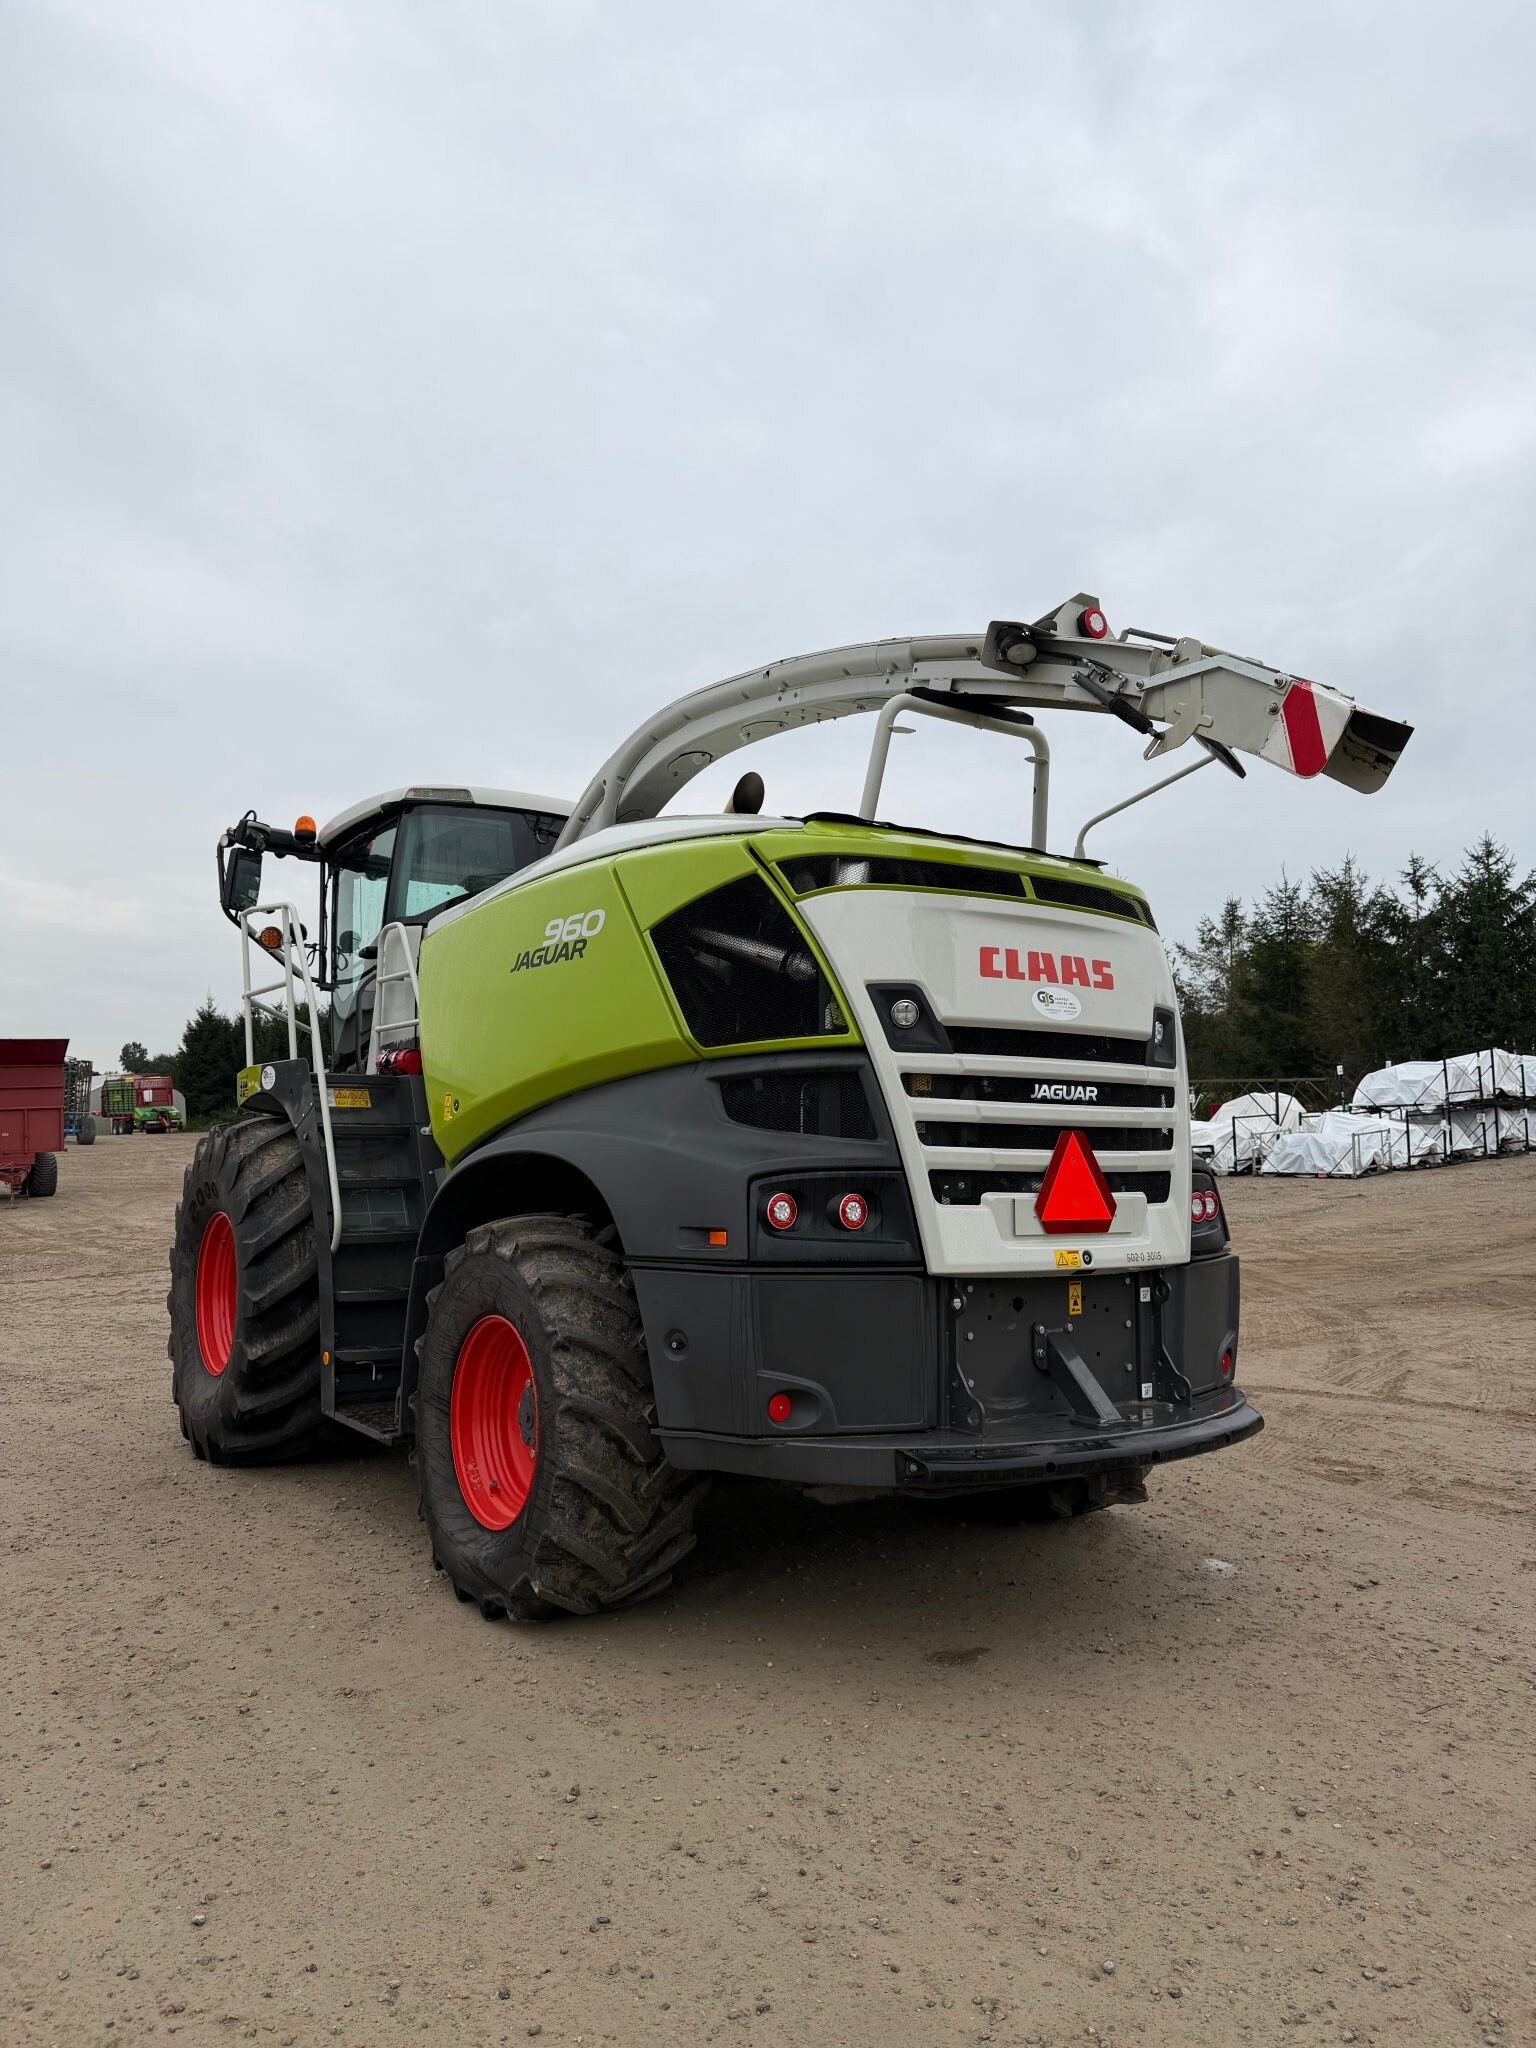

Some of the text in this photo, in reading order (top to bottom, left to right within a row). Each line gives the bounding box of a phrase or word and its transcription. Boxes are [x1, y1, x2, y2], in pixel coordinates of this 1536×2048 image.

[543, 909, 606, 946] 960
[510, 938, 588, 973] JAGUAR
[980, 947, 1114, 990] CLAAS
[1030, 1083, 1098, 1102] JAGUAR
